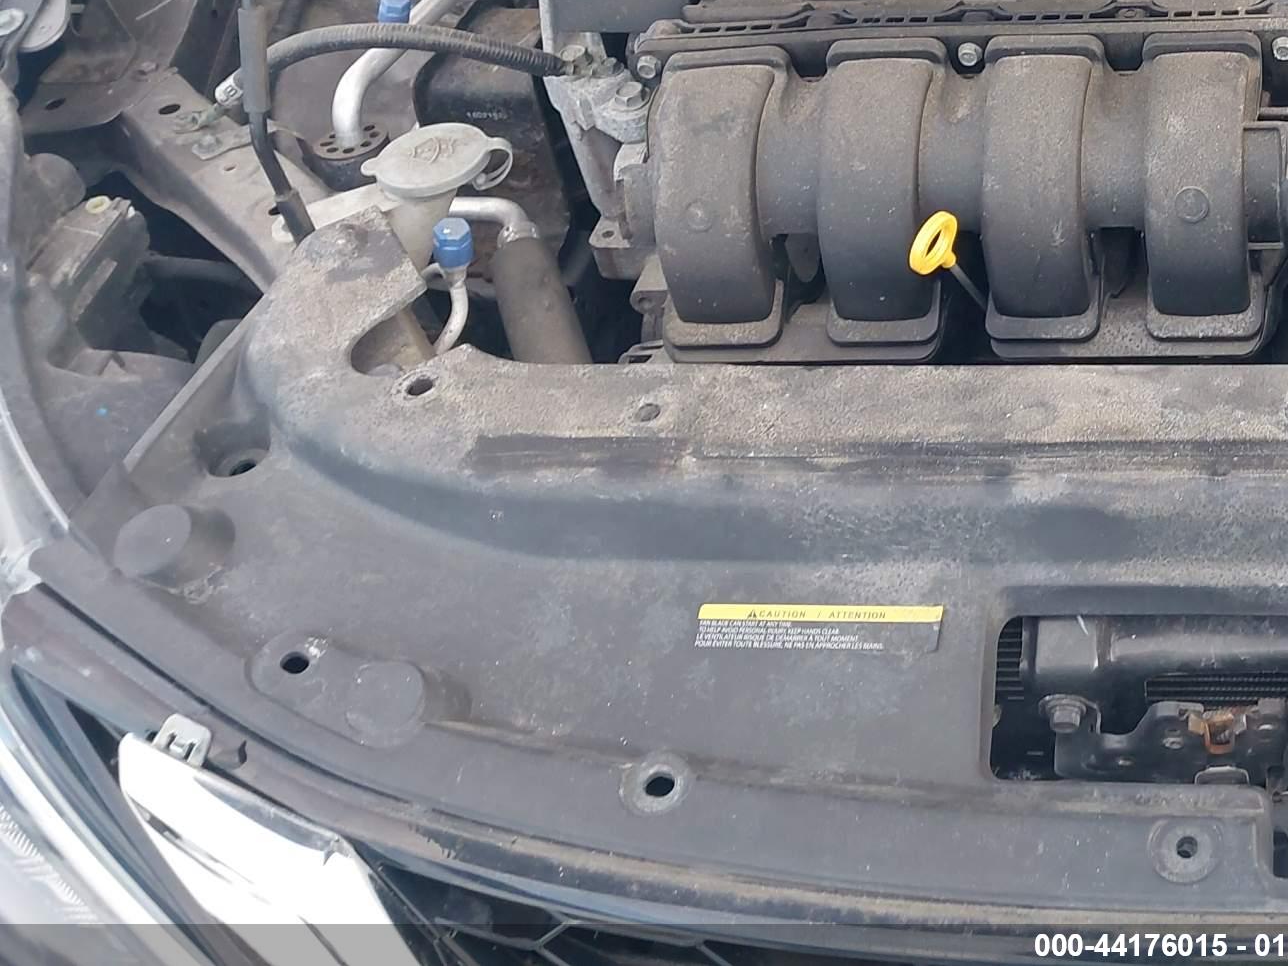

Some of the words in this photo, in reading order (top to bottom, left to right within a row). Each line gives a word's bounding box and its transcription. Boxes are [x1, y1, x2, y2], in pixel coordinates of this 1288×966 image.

[759, 610, 806, 618] CAUTION
[828, 611, 886, 619] ATTENTION
[733, 640, 752, 648] TOUTE
[814, 641, 851, 649] APPROCHER
[851, 642, 863, 650] LES
